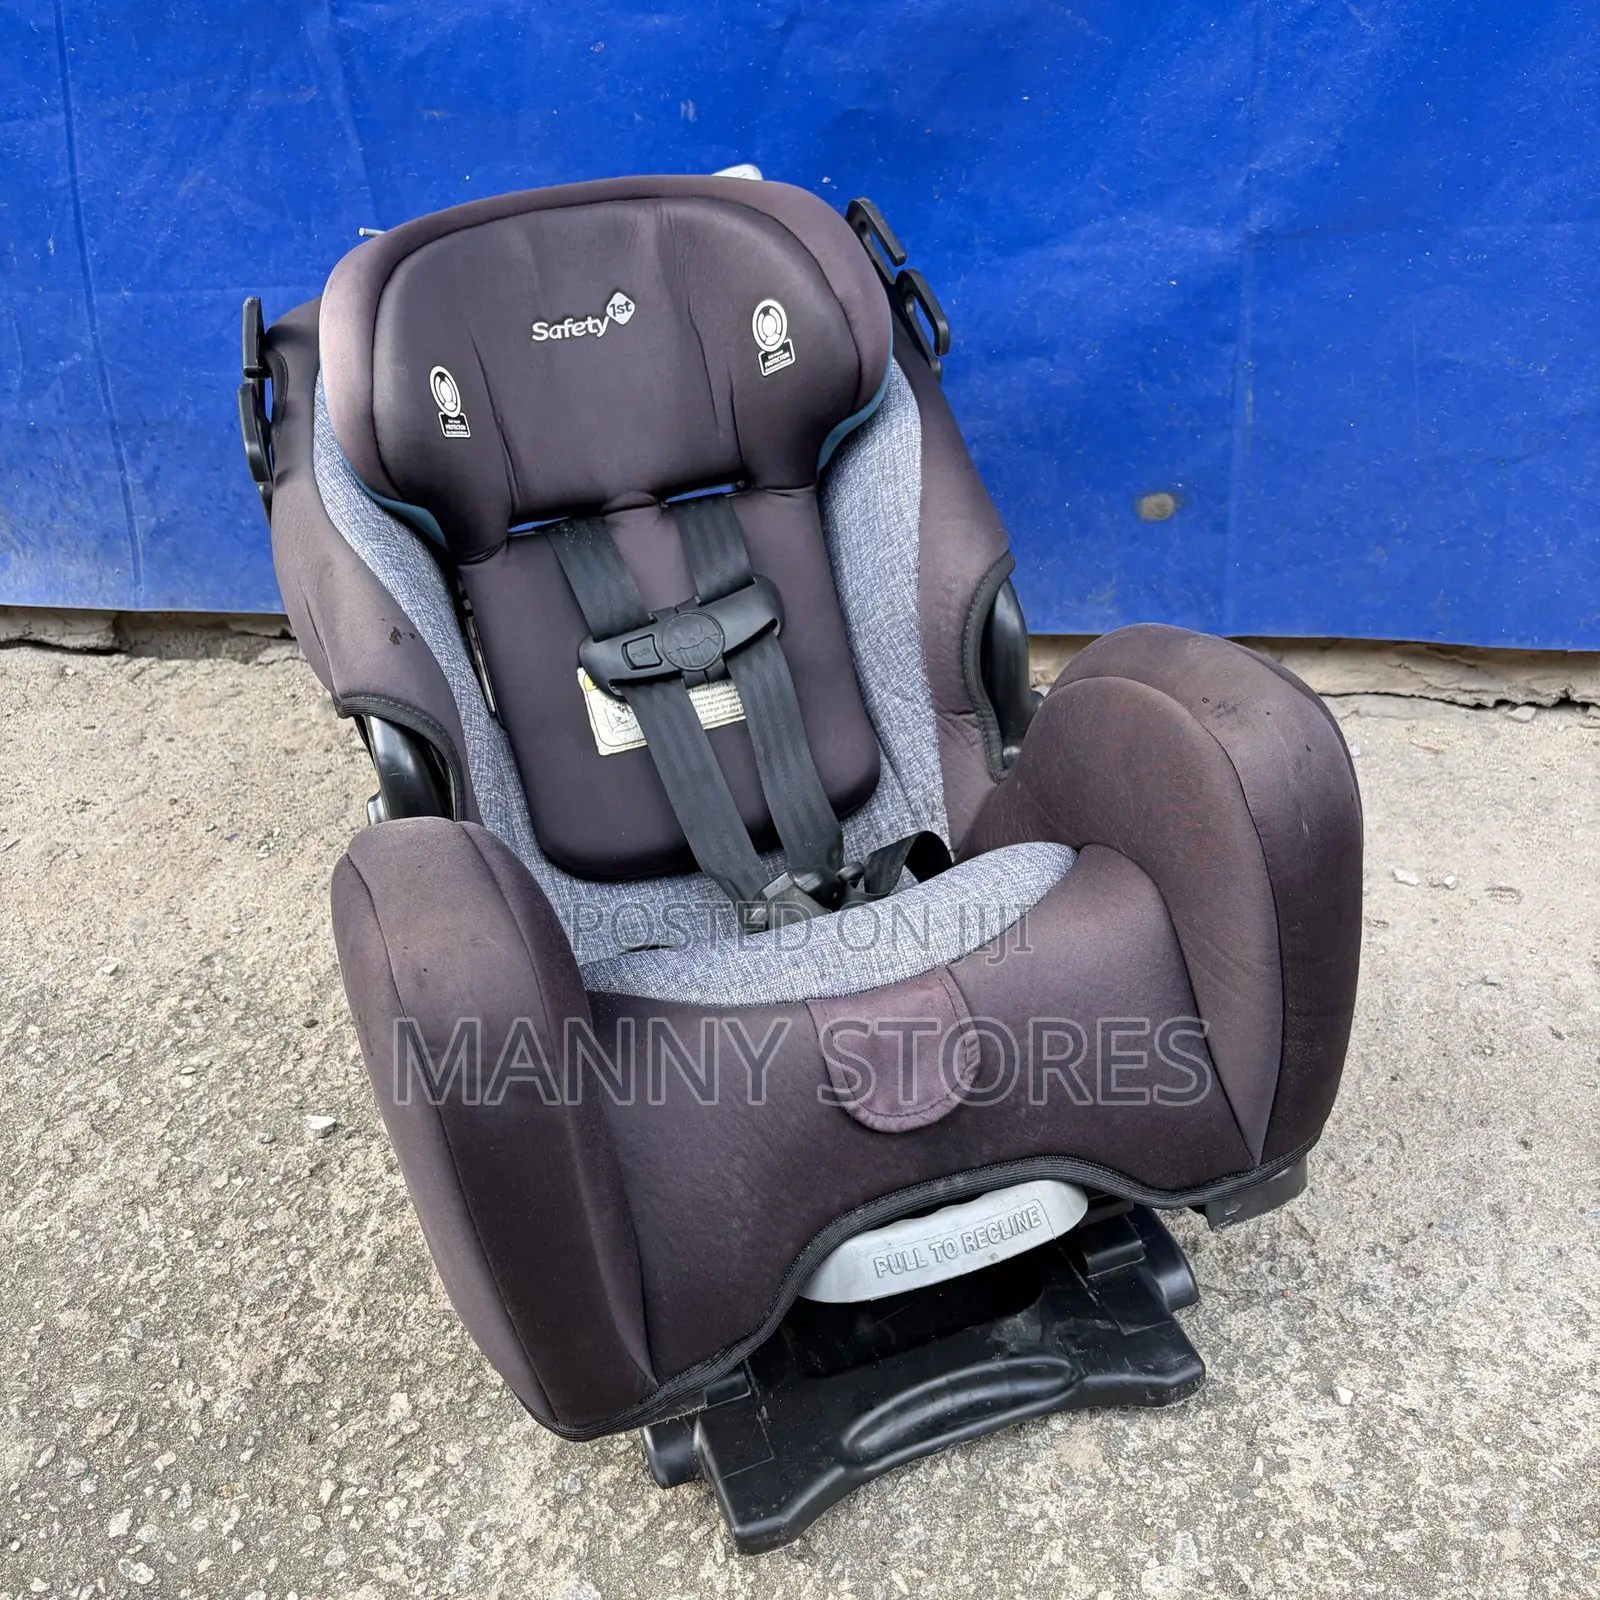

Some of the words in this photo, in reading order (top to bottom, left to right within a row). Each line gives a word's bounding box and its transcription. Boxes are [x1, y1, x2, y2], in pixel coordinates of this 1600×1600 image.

[532, 316, 609, 341] Safety
[608, 300, 632, 318] 1st
[873, 1247, 929, 1278] PULL
[929, 1237, 959, 1263] TO
[960, 1205, 1042, 1254] RECLINE
